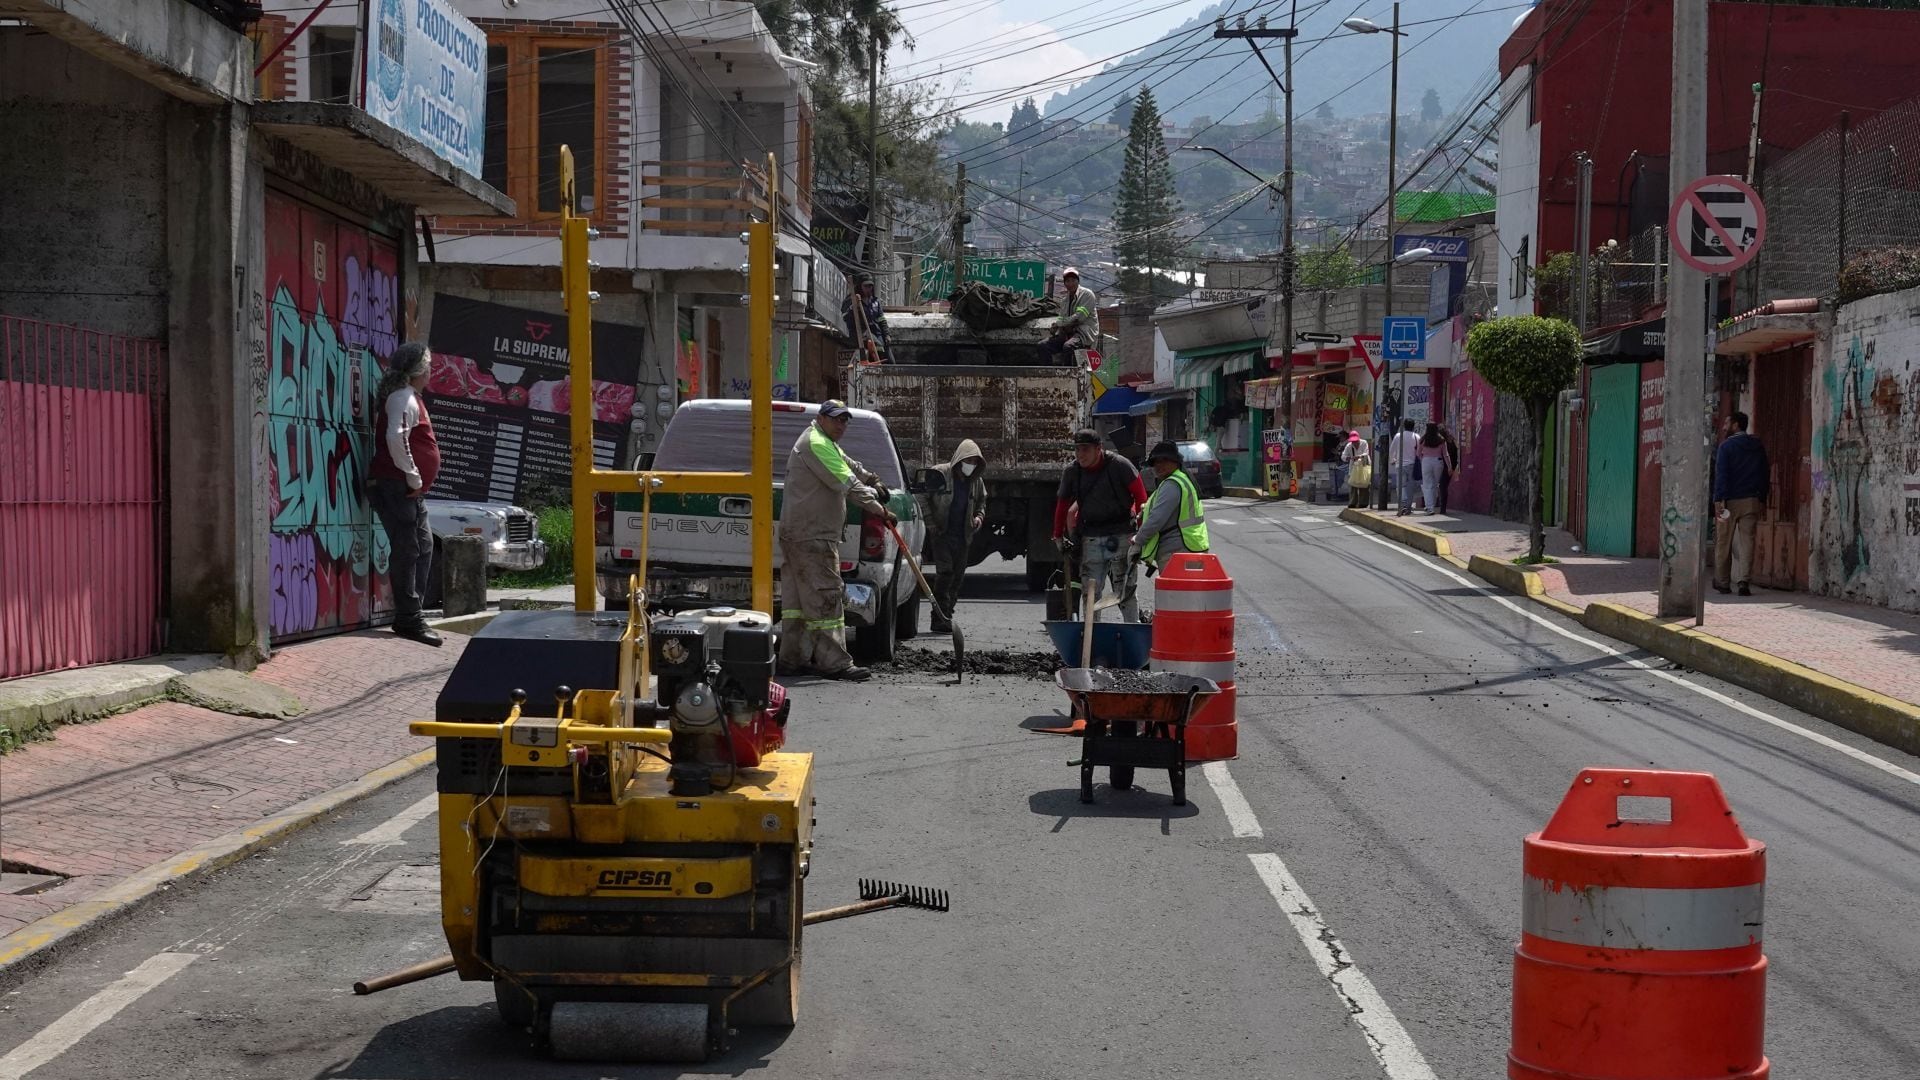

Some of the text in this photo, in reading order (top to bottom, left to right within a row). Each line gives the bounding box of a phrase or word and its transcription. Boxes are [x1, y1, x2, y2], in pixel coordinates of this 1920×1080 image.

[416, 0, 480, 74] PRODUCTOS
[440, 64, 455, 103] DE
[420, 97, 470, 158] LIMPIEZA
[813, 227, 846, 241] PARTY
[1418, 239, 1464, 255] telcel
[943, 261, 992, 278] CRRIL
[999, 266, 1008, 279] A
[1017, 267, 1035, 281] LA
[493, 337, 510, 353] LA
[433, 399, 486, 413] PRODUCTOS RES
[531, 415, 555, 424] VARIOS
[598, 870, 673, 887] CIPSA
